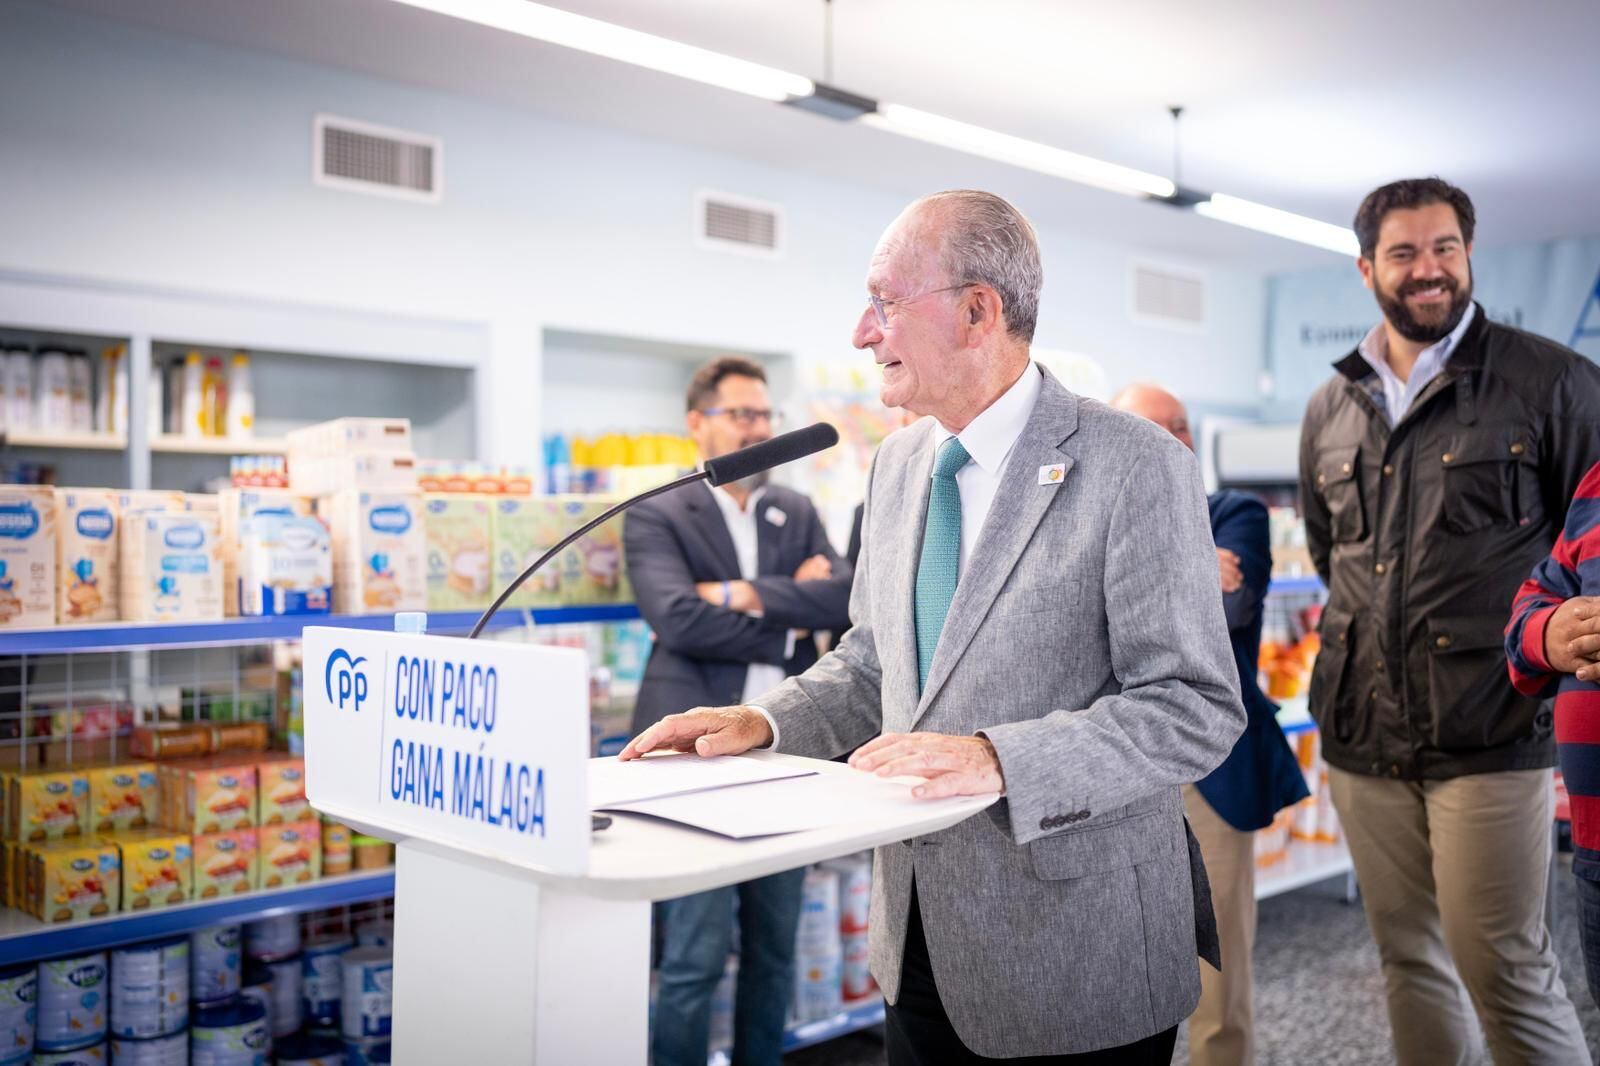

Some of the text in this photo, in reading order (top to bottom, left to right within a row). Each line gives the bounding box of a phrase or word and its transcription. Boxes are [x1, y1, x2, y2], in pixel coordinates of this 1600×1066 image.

[395, 655, 498, 733] CON PACO
[390, 738, 546, 838] GANA MÁLAGA
